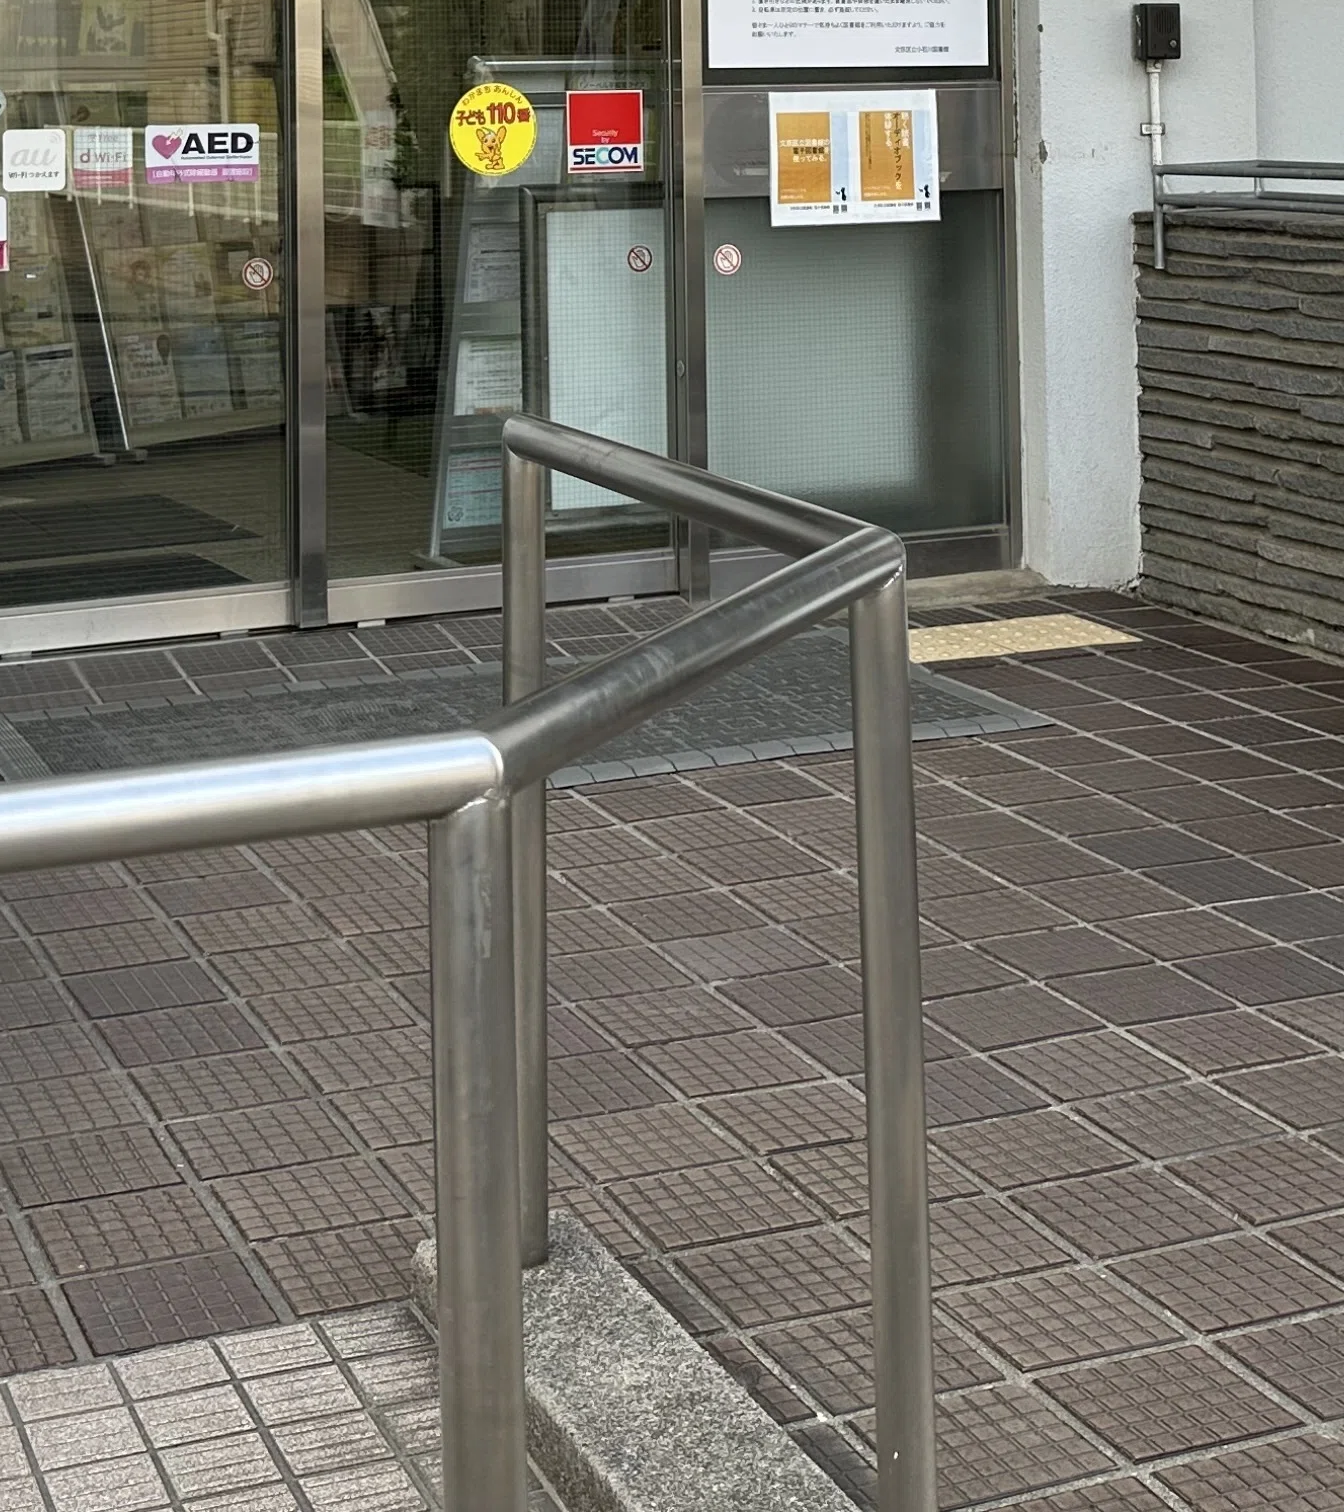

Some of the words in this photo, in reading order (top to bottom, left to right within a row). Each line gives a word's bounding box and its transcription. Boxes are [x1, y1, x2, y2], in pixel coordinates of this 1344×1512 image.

[592, 129, 619, 138] Security
[181, 133, 254, 155] AED
[10, 148, 58, 167] au
[573, 147, 638, 166] SECOM
